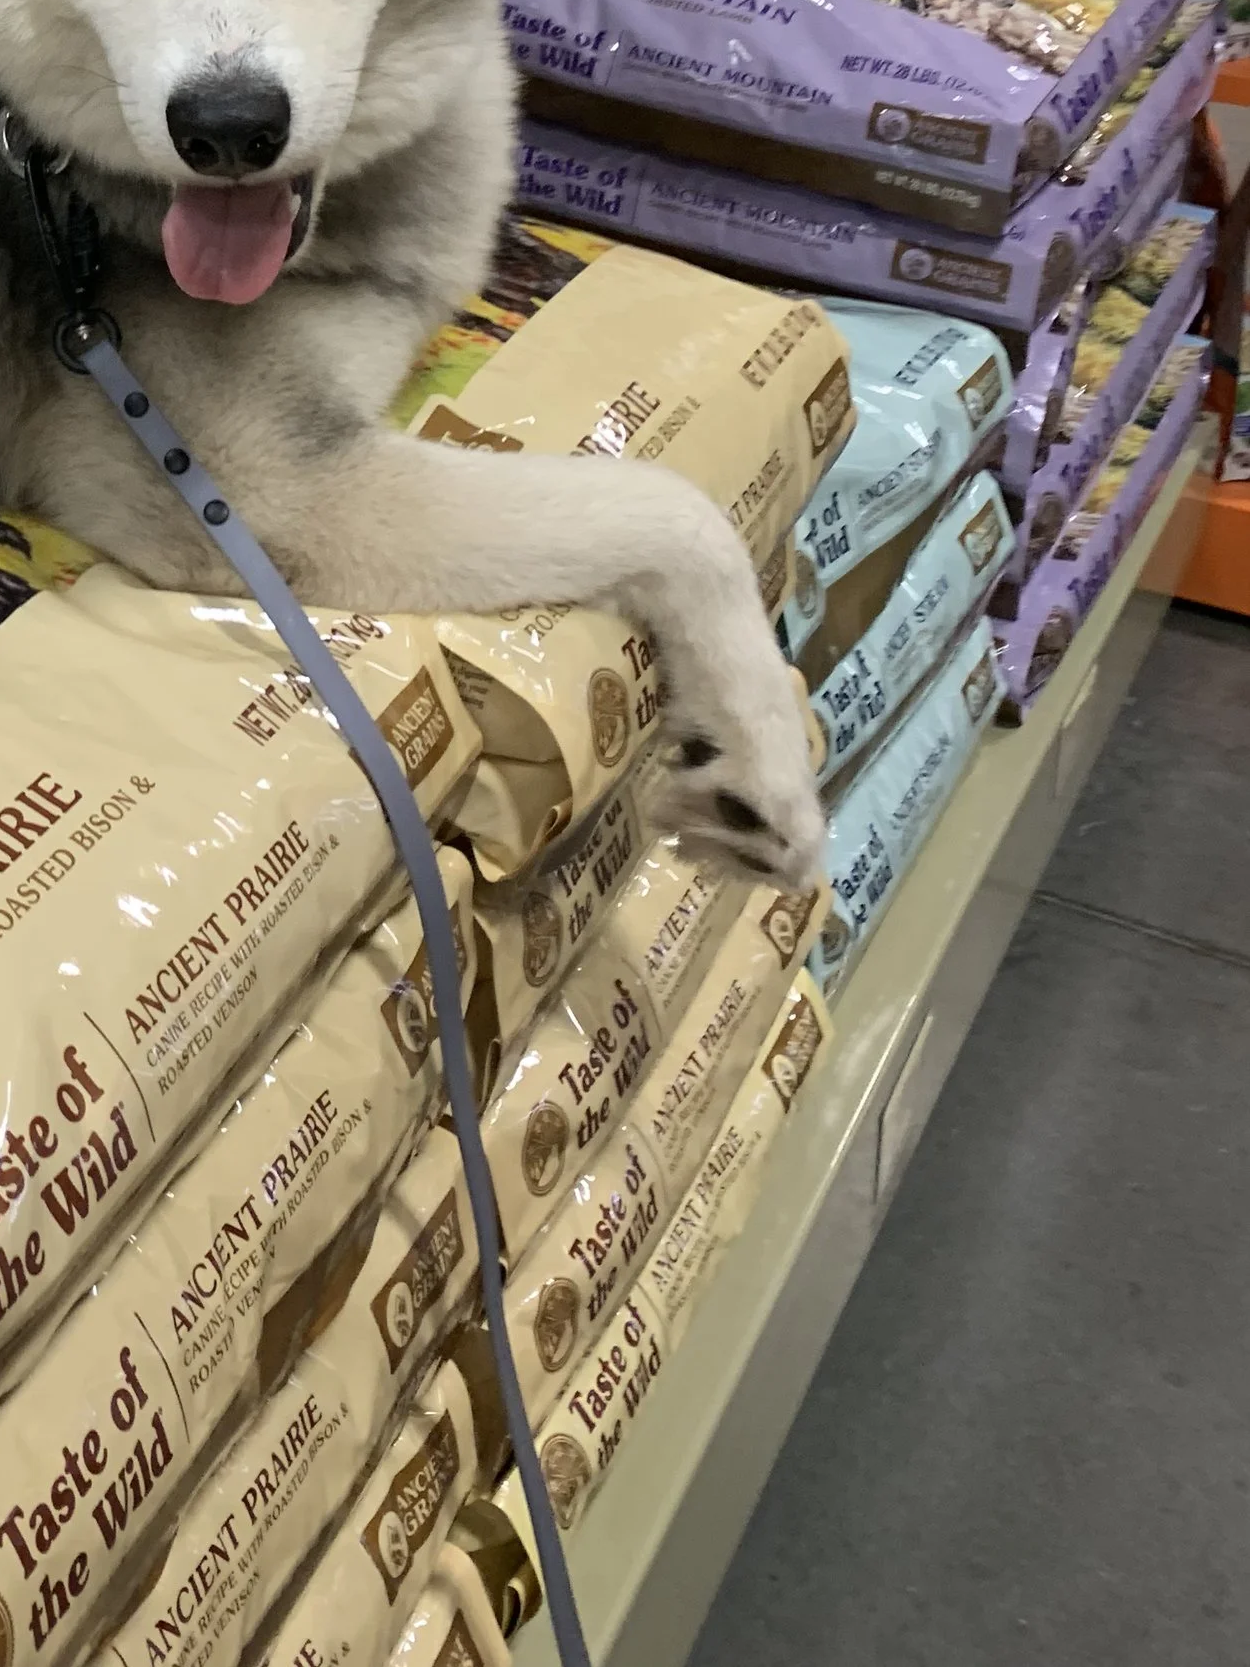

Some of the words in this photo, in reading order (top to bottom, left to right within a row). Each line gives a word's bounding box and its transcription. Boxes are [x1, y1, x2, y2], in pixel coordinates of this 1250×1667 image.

[501, 1, 568, 42] Taste
[574, 29, 607, 52] of
[538, 42, 598, 79] Wild
[840, 55, 870, 73] NET
[628, 44, 717, 78] ANCIENT
[722, 69, 834, 107] MOUNTAIN
[1051, 73, 1100, 134] Taste
[521, 144, 590, 181] Taste
[597, 164, 630, 189] of
[563, 178, 622, 218] Wild
[650, 182, 737, 216] ANCIENT
[822, 491, 843, 527] of
[390, 685, 438, 748] ANCIENT
[404, 706, 447, 769] GRAINS
[68, 791, 133, 857] BISON
[132, 773, 158, 796] &
[567, 892, 594, 943] the
[591, 824, 635, 898] Wild
[123, 911, 231, 1047] ANCIENT
[223, 820, 311, 927] PRAIRIE
[647, 897, 702, 979] ANCIENT
[157, 1016, 214, 1098] ROASTED
[209, 968, 260, 1034] VENISON
[557, 1028, 620, 1109] Taste
[612, 978, 640, 1029] of
[652, 1049, 704, 1142] ANCIENT
[700, 978, 748, 1064] PRAIRIE
[56, 1043, 105, 1126] of
[576, 1099, 612, 1152] the
[612, 1026, 653, 1099] Wild
[39, 1104, 139, 1237] Wild
[568, 1203, 628, 1280] Taste
[624, 1142, 649, 1200] of
[649, 1198, 703, 1293] ANCIENT
[695, 1122, 746, 1214] PRAIRIE
[168, 1190, 265, 1345] ANCIENT
[259, 1089, 341, 1206] PRAIRIE
[586, 1274, 619, 1322] the
[619, 1188, 661, 1270] Wild
[110, 1346, 150, 1421] of
[567, 1339, 631, 1437] Taste
[624, 1299, 650, 1350] of
[596, 1416, 624, 1472] the
[624, 1334, 664, 1420] Wild
[28, 1551, 90, 1653] the
[90, 1412, 174, 1551] Wild
[142, 1513, 239, 1666] ANCIENT
[240, 1394, 324, 1525] PRAIRIE
[212, 1570, 263, 1634] VENISON
